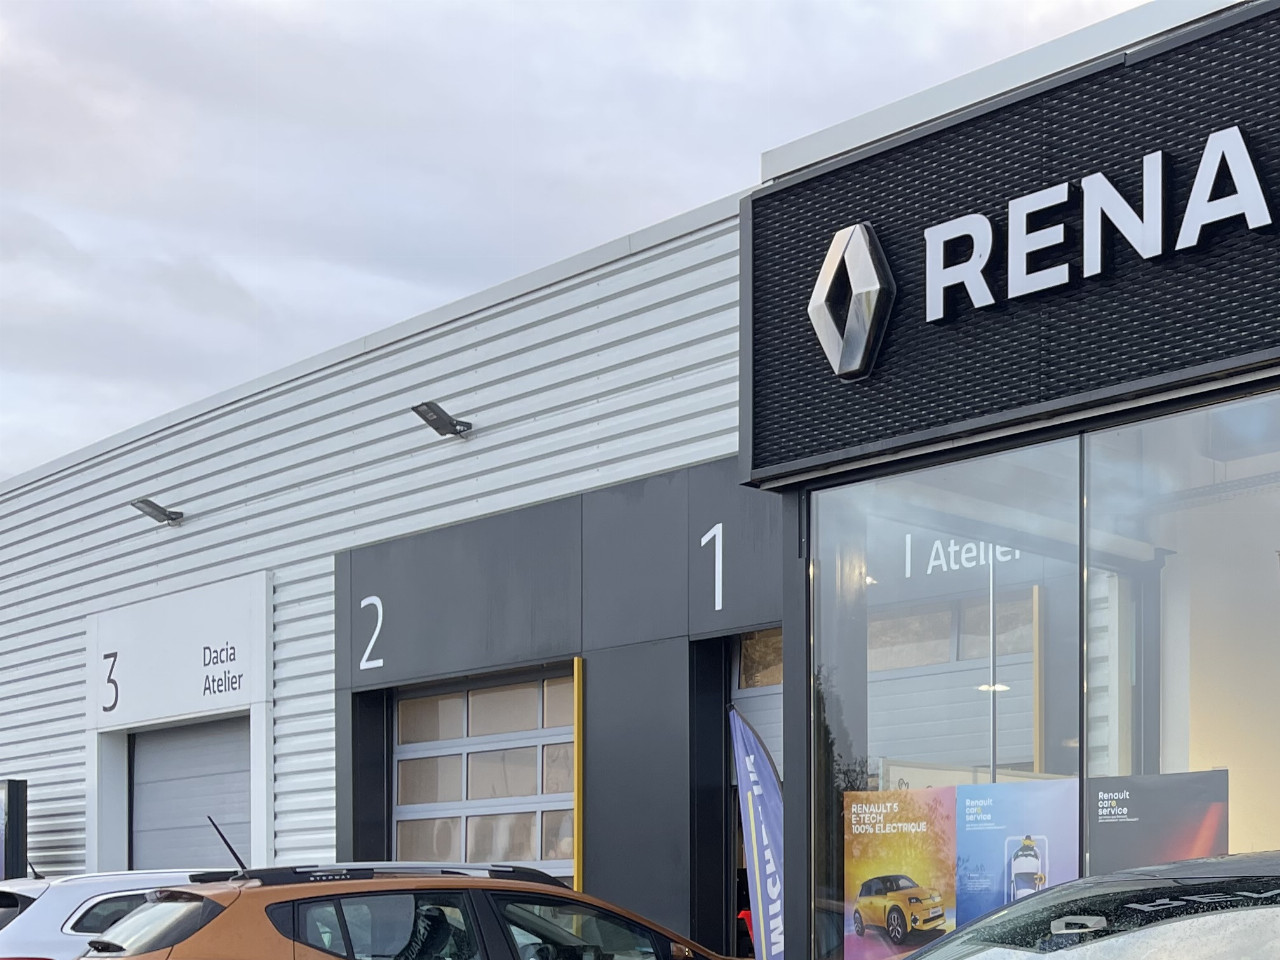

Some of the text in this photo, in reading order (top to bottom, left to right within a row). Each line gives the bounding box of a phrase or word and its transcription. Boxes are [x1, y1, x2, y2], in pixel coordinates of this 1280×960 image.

[701, 522, 723, 611] 1
[359, 595, 384, 670] 2
[203, 641, 236, 667] Dacia
[102, 651, 119, 712] 3
[203, 670, 243, 696] Atelier
[1098, 790, 1130, 800] Renault
[852, 802, 899, 813] RENAULT 5
[965, 798, 993, 807] Renault
[1098, 799, 1117, 808] care
[1098, 806, 1128, 816] service
[852, 813, 884, 824] E-TECH
[965, 813, 992, 822] service
[852, 824, 874, 835] 100%
